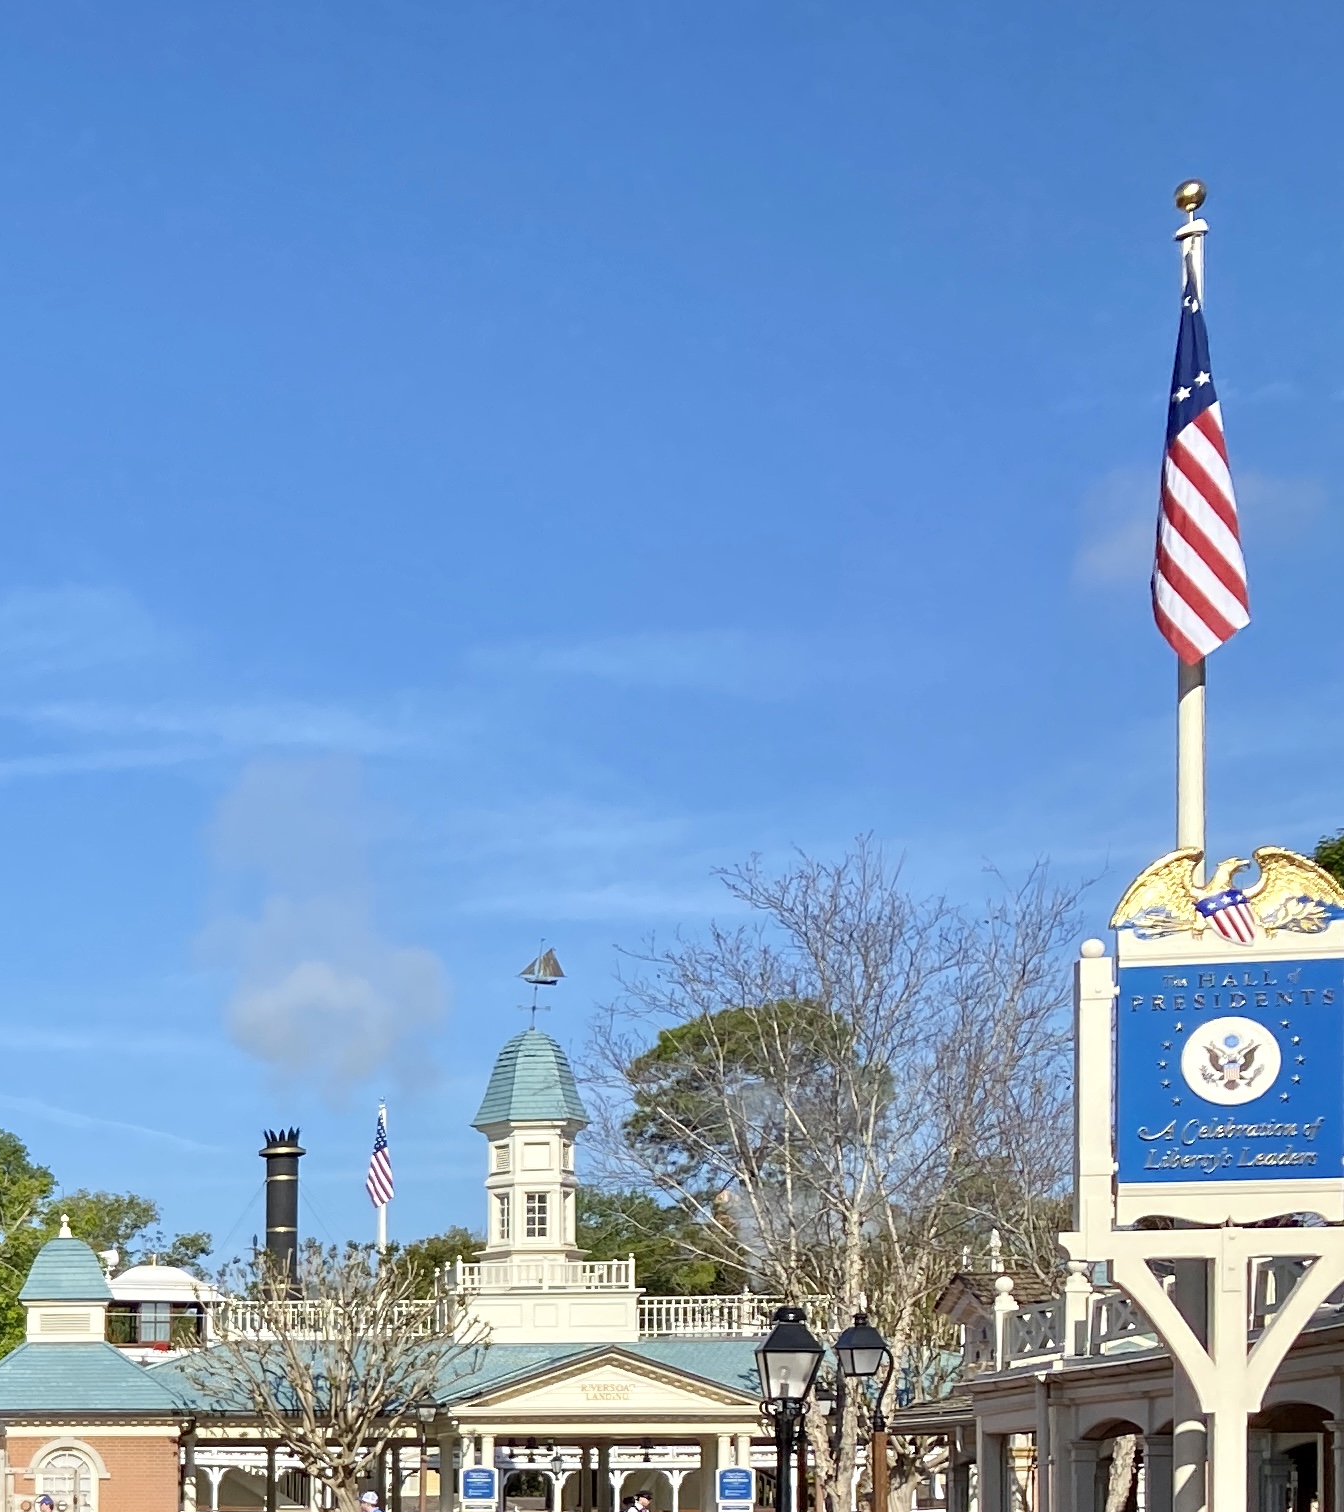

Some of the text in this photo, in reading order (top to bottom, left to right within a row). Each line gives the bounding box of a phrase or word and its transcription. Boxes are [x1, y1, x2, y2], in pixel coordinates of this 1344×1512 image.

[1197, 968, 1278, 989] HALL
[1287, 967, 1303, 985] of
[1130, 987, 1336, 1012] PRESIDENTS
[1137, 1116, 1326, 1146] A Celebration of
[1143, 1144, 1319, 1174] Liberty's Leaders
